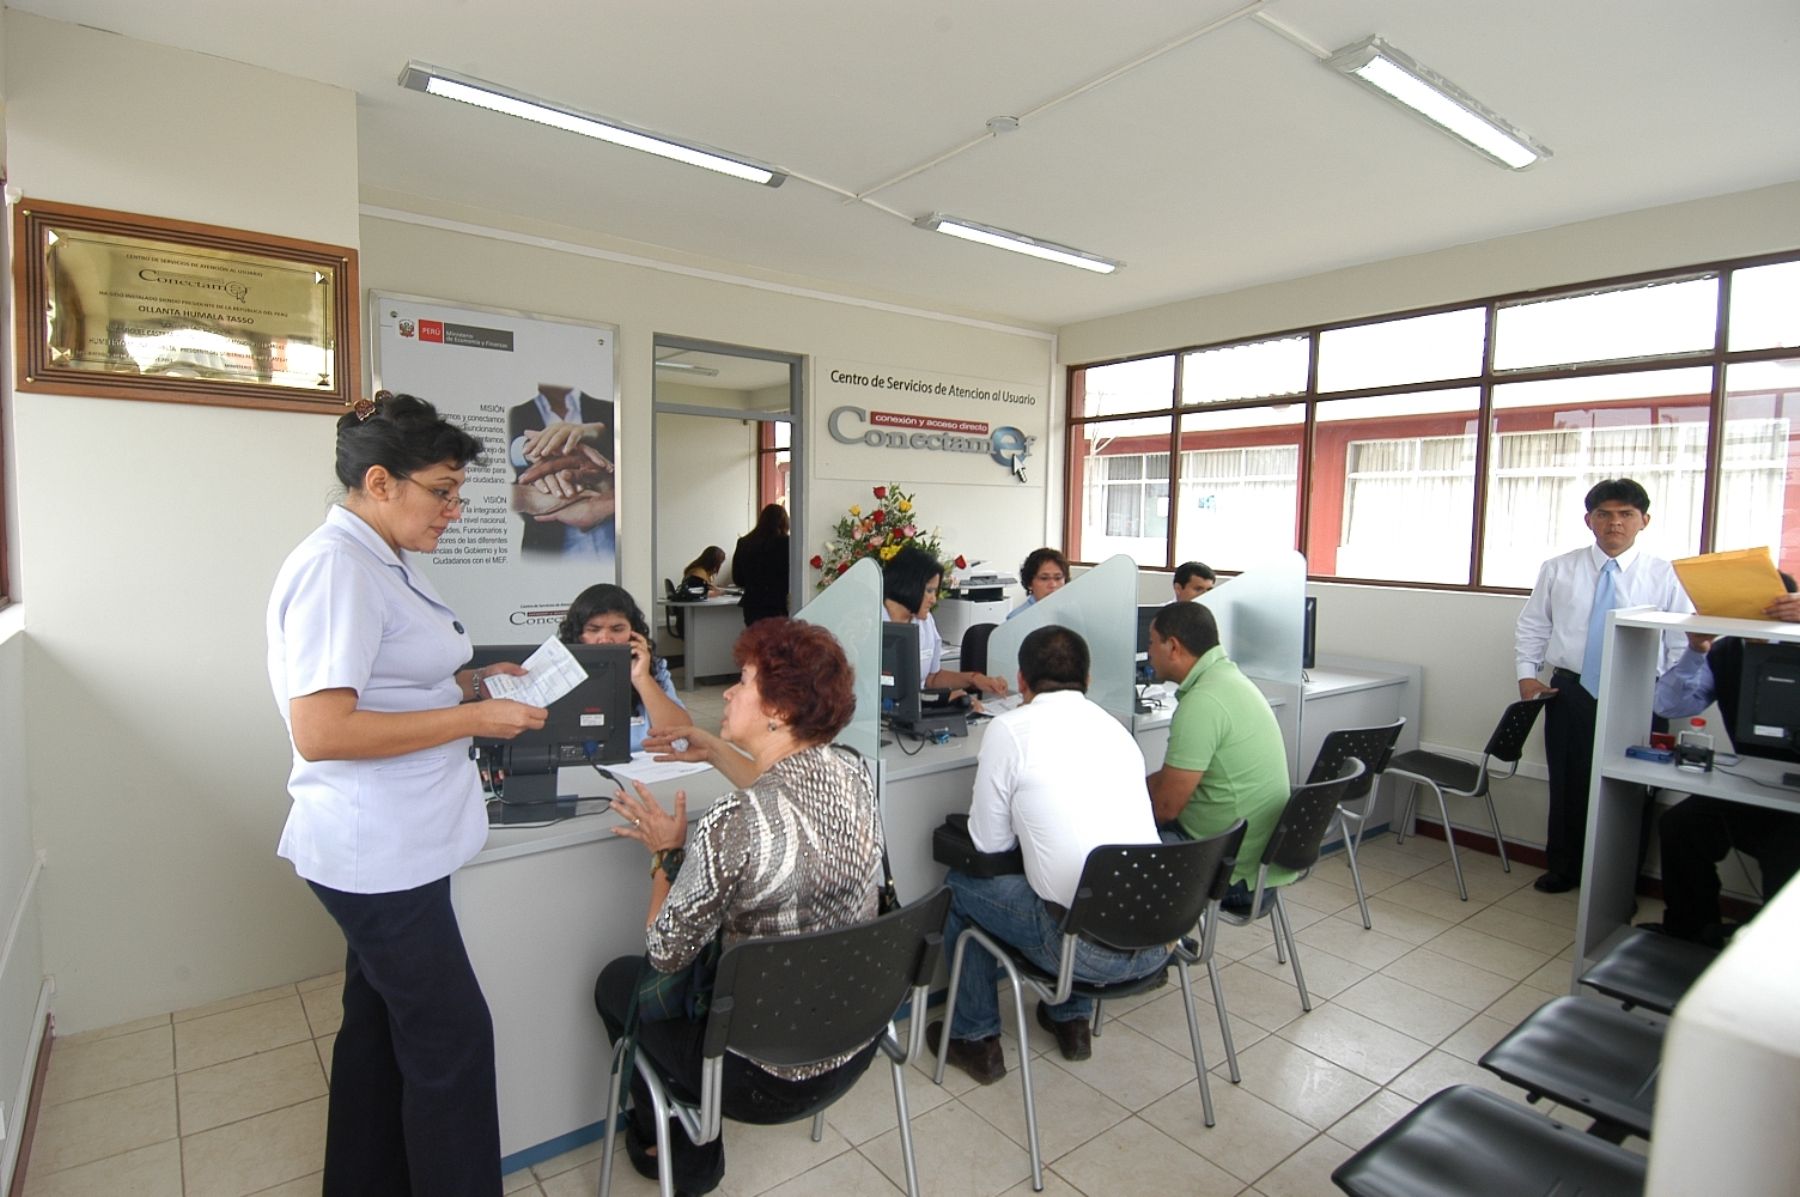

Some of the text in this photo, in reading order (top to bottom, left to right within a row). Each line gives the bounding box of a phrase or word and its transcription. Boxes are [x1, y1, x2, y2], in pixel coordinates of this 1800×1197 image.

[138, 304, 255, 325] OLLANTA HUMALA TASSO
[422, 327, 441, 336] PERÚ
[830, 370, 1036, 406] Centro de Servicios de Atencion al Usuario
[480, 404, 505, 413] MISIÓN
[467, 414, 505, 424] conectamos
[875, 414, 988, 432] conexión y acceso directo
[492, 467, 506, 475] para
[483, 495, 507, 503] VISIÓN
[473, 506, 507, 515] integración
[462, 526, 502, 534] Funcionarios
[477, 536, 508, 544] diferentes
[463, 546, 492, 554] Gobierno
[498, 546, 508, 554] los
[432, 557, 471, 565] Ciudadanos
